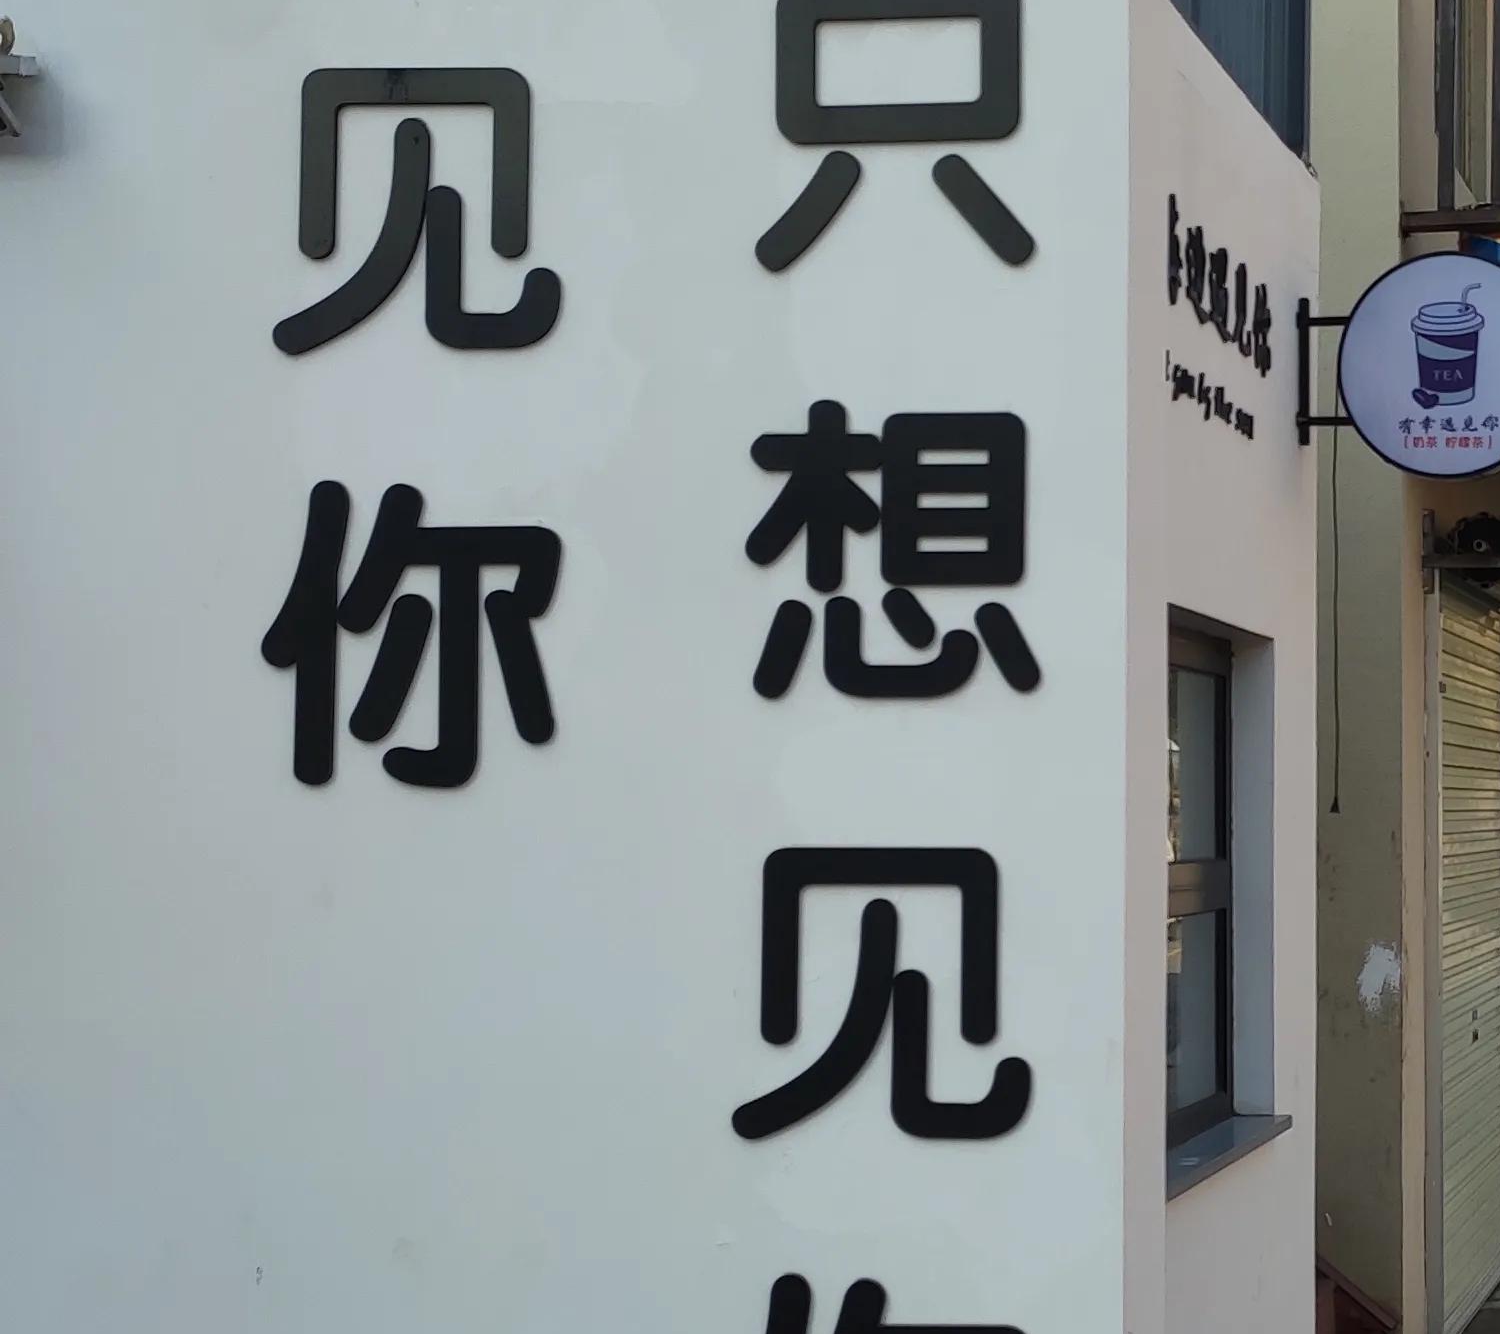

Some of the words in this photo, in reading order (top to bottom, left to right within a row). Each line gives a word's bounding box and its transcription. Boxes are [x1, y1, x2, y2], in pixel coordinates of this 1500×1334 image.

[1433, 369, 1464, 382] TEA
[1398, 415, 1500, 435] 有幸遇见你
